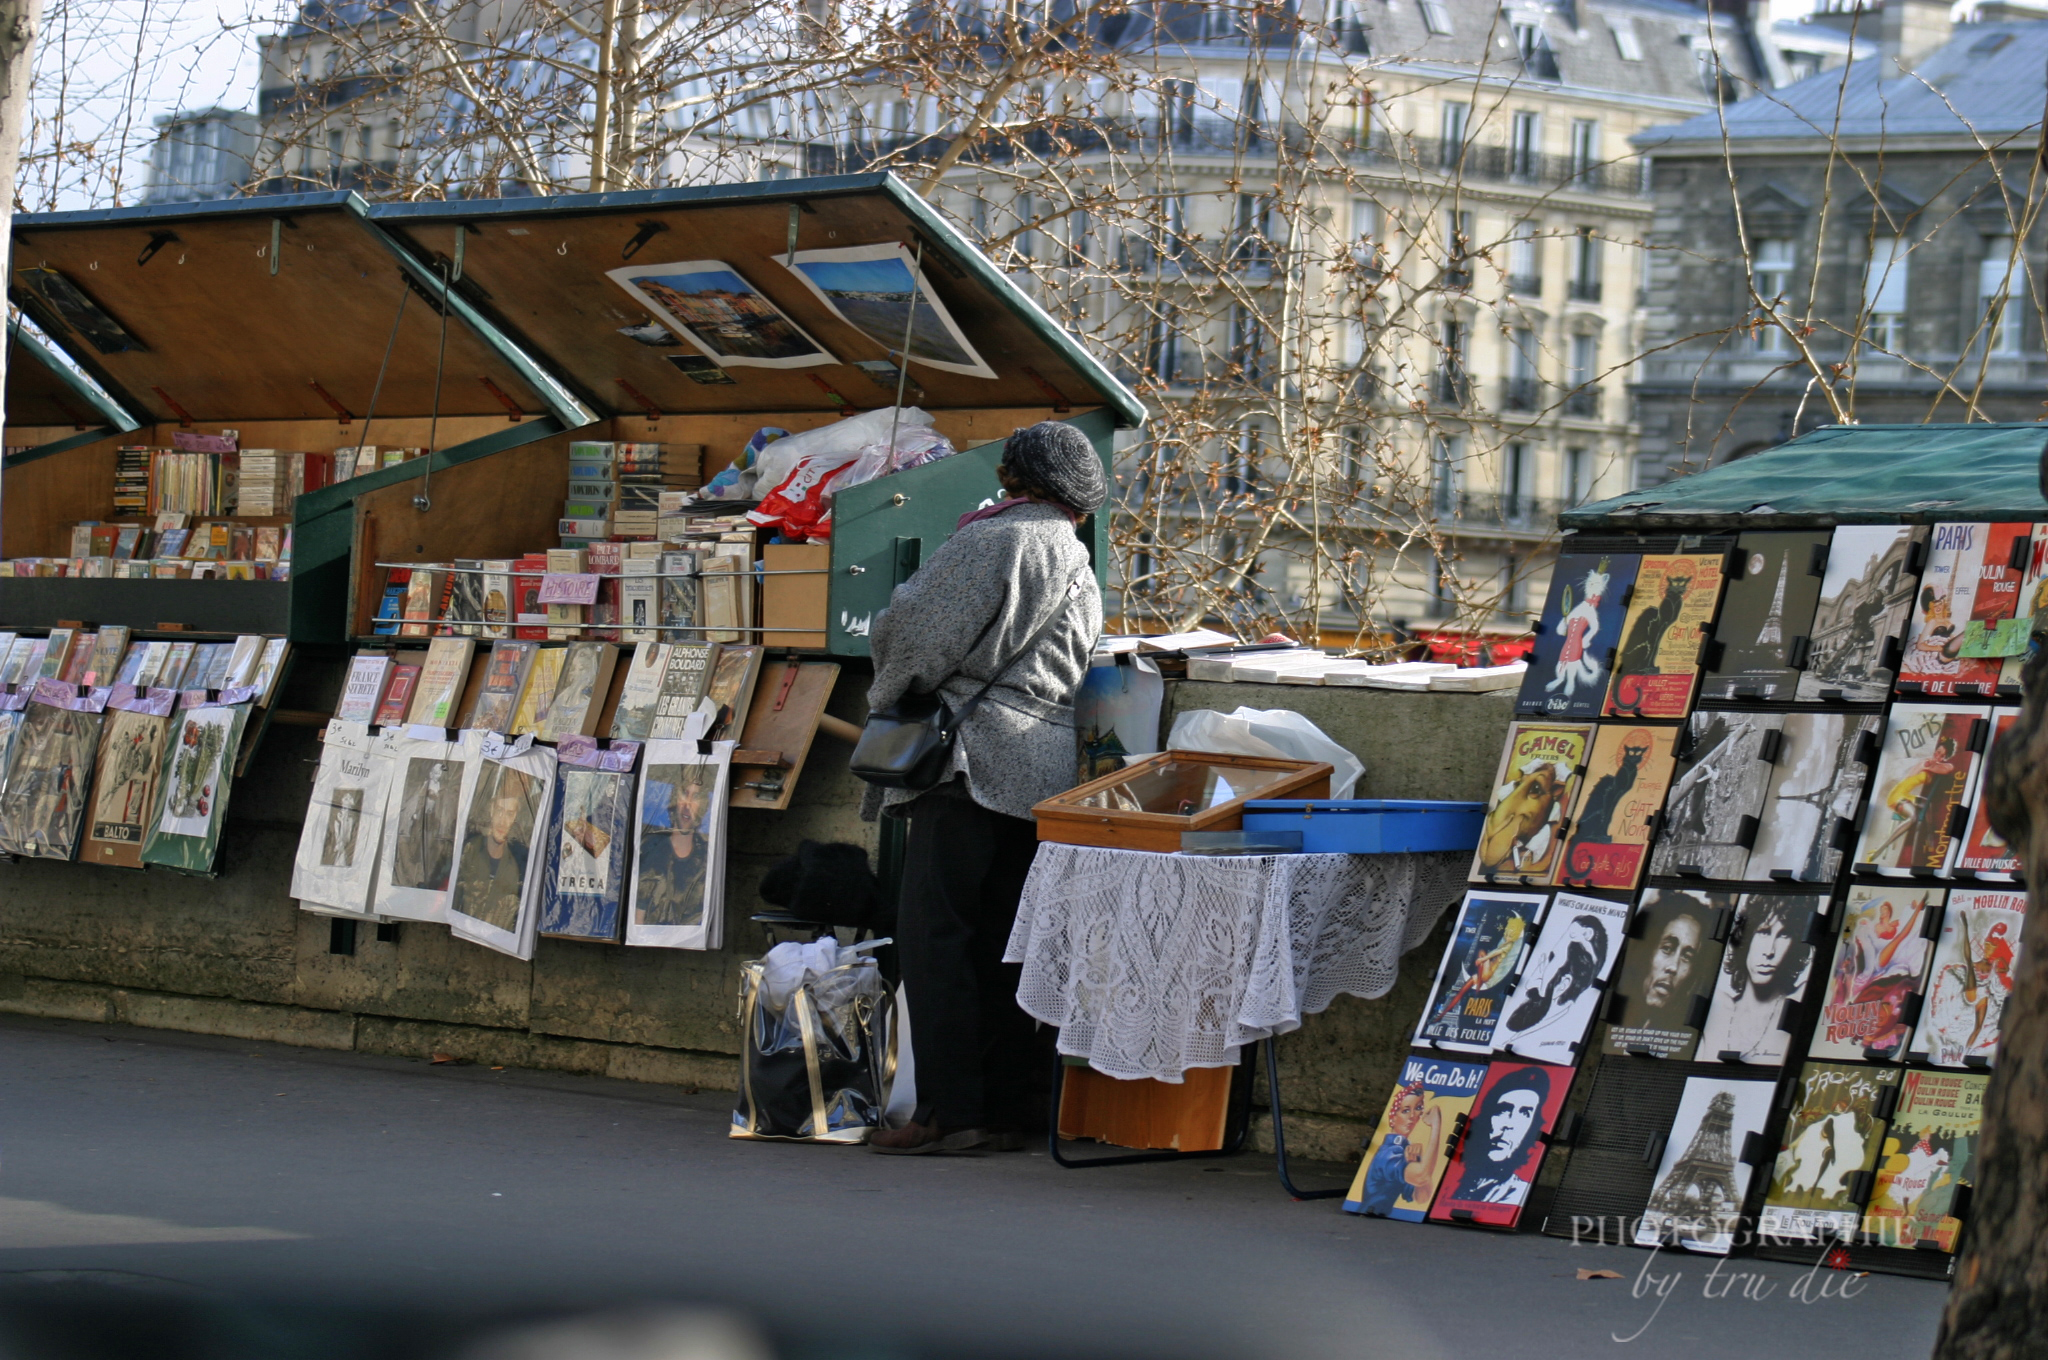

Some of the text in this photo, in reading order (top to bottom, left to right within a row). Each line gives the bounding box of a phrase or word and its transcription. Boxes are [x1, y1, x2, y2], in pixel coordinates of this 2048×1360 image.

[1935, 525, 1974, 551] PARIS
[588, 555, 620, 565] LOMBARD
[1978, 564, 2006, 579] OULIN
[545, 580, 595, 597] HISTOIRE
[1993, 581, 2016, 592] ROUGE
[672, 648, 710, 659] ALPHONSE
[669, 660, 706, 670] BOUDARD
[351, 672, 380, 682] FRANCE
[1931, 681, 1945, 693] DE
[1898, 713, 1942, 758] Paris
[1519, 736, 1575, 760] CAMEL
[1530, 753, 1559, 761] FILTERS
[341, 759, 370, 779] Marilyn
[1624, 800, 1653, 821] CHAT
[104, 824, 130, 839] BALTO
[1963, 857, 1982, 869] VILLE
[1983, 858, 1992, 869] DU
[1973, 895, 2029, 914] MOULIN ROU
[1607, 908, 1627, 918] MIND
[1464, 997, 1493, 1018] PARIS
[1822, 1001, 1880, 1026] MOULIN
[1425, 1025, 1490, 1041] VILLE DES FOLIES
[1825, 1019, 1878, 1044] ROUGE
[1405, 1062, 1483, 1089] We Can Do It!
[1941, 1077, 1963, 1088] ROUGE
[1964, 1080, 1987, 1091] CONCE
[1934, 1098, 1957, 1108] ROUGE
[1937, 1088, 1960, 1098] ROUGE
[1965, 1093, 1982, 1105] BA
[1932, 1109, 1974, 1119] GOULUE
[1902, 1177, 1927, 1191] ROUGE
